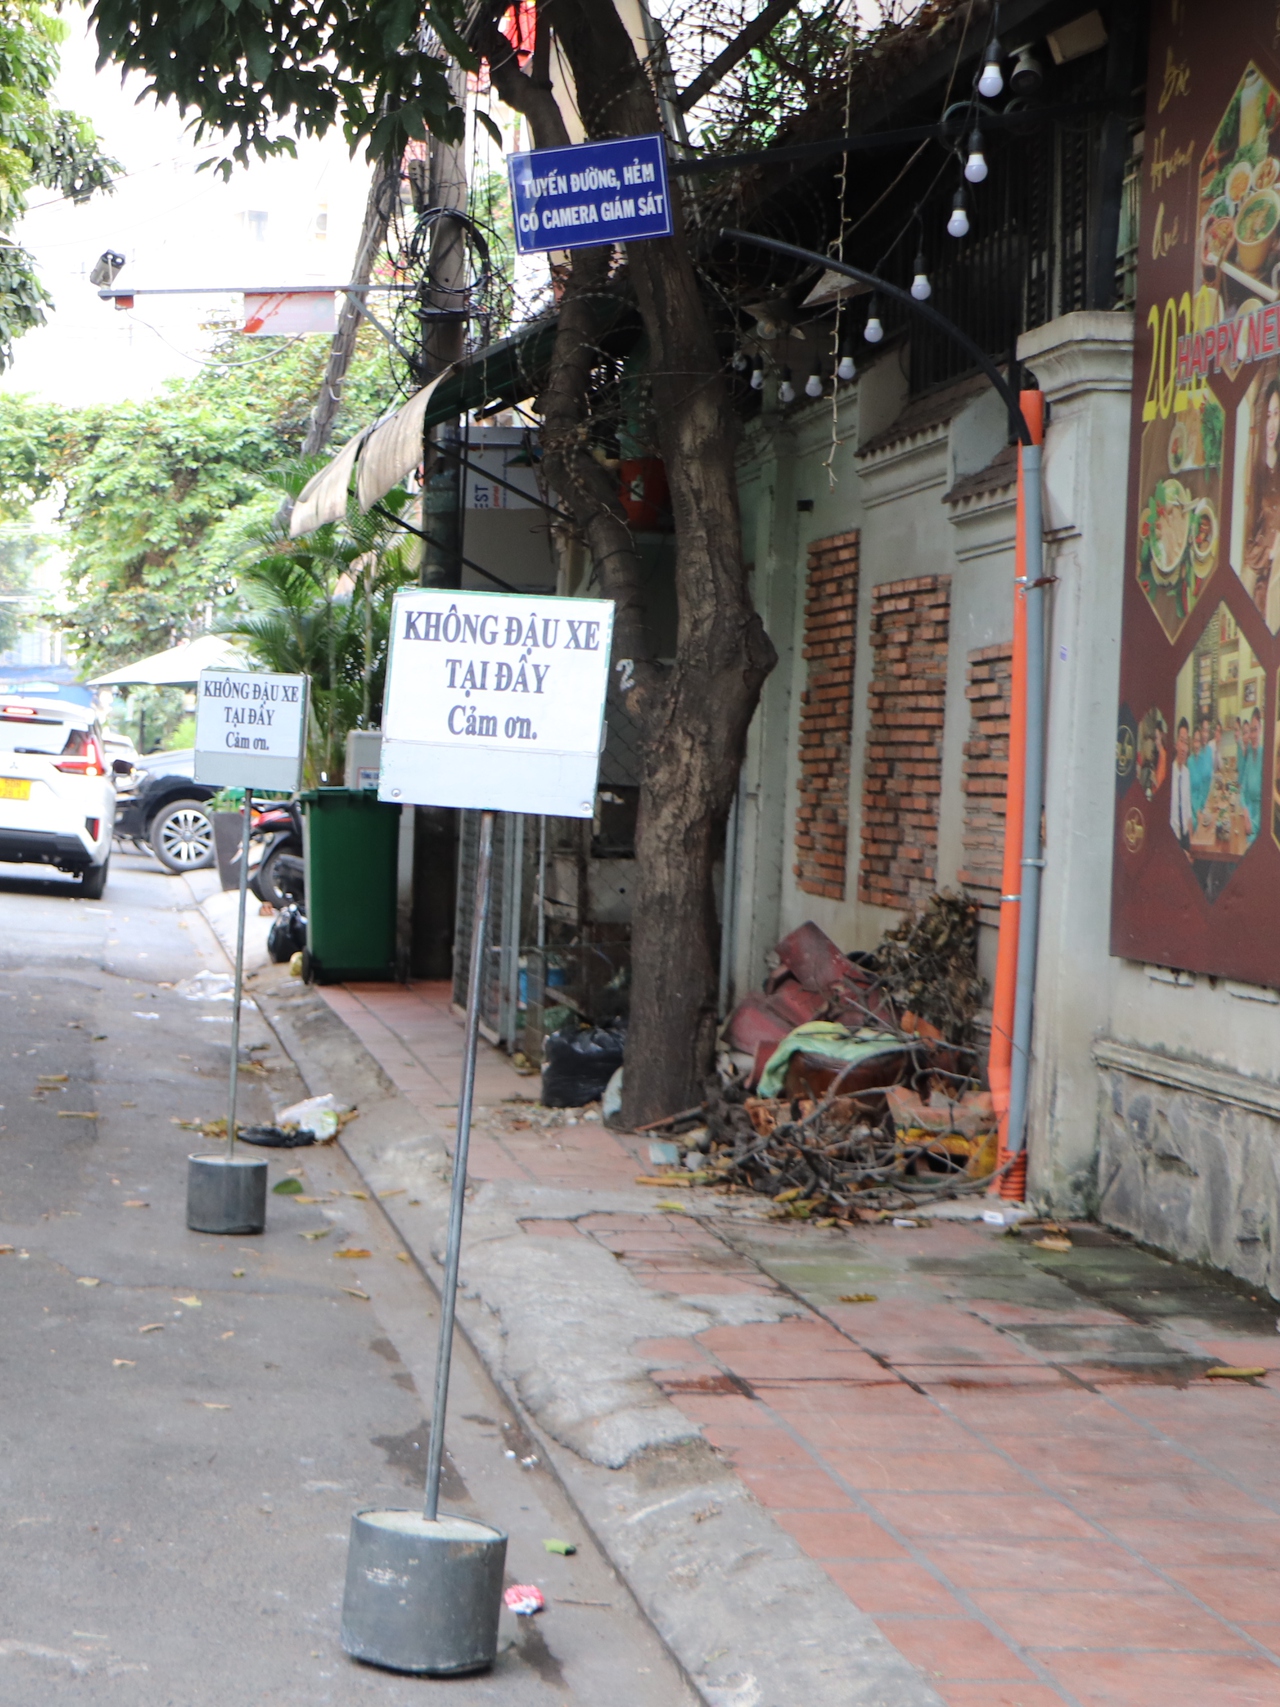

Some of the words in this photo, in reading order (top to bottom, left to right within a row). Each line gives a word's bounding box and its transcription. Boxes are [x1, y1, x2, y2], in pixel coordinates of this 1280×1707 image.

[522, 169, 568, 199] TUYẾN
[570, 166, 621, 193] ĐƯỜNG,
[623, 158, 655, 186] HẺM
[520, 208, 539, 233] CÓ
[542, 205, 599, 230] CAMERA
[601, 196, 636, 222] GIÁM
[638, 191, 664, 217] SÁT
[1176, 316, 1245, 387] HAPPY
[1245, 300, 1280, 365] NE
[403, 604, 499, 645] KHÔNG
[503, 612, 560, 656] ĐẬU
[563, 619, 601, 651] XE
[203, 677, 250, 700] KHÔNG
[252, 681, 280, 705] ĐẬU
[281, 685, 299, 702] XE
[446, 658, 491, 698] TẠI
[494, 653, 551, 694] ĐÂY
[615, 658, 635, 692] 2
[224, 706, 246, 728] TẠI
[248, 704, 275, 726] ĐÂY
[447, 704, 498, 738] Cảm
[504, 716, 538, 741] ơn.
[226, 731, 250, 749] Cảm
[253, 737, 270, 751] ơn.
